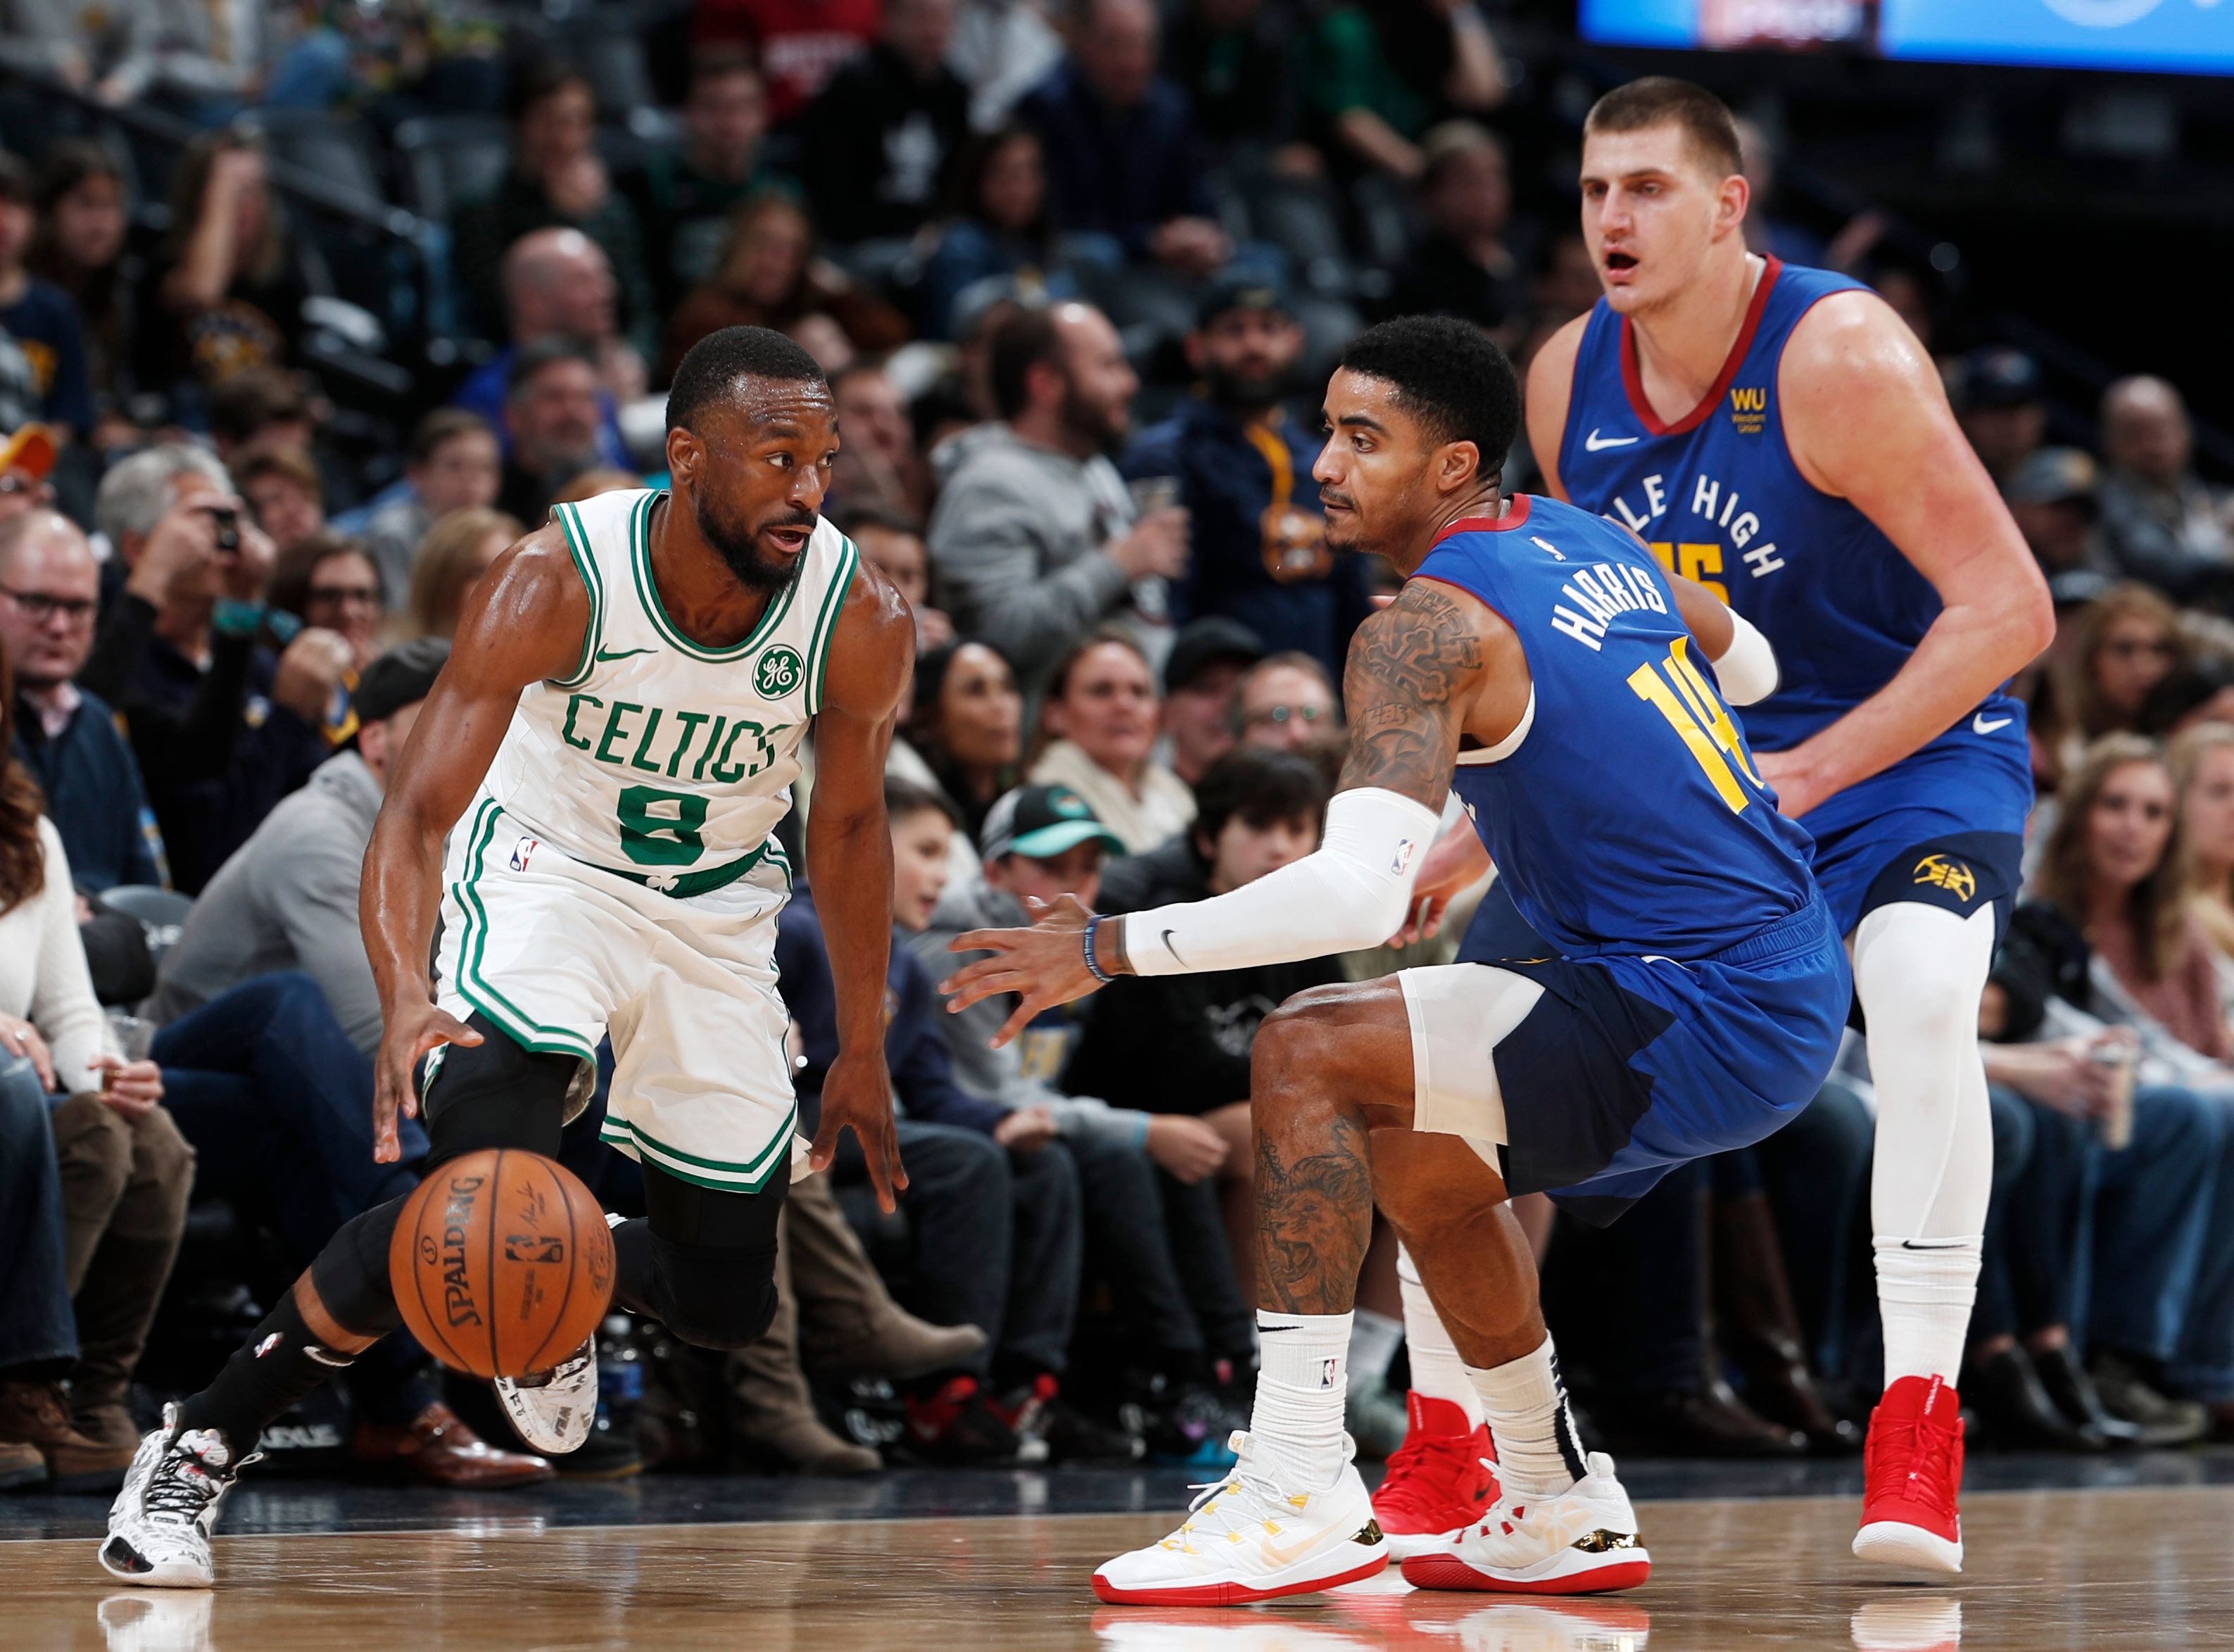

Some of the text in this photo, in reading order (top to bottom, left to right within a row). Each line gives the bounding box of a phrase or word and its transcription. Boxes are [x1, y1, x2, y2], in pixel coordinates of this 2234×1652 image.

[1731, 388, 1765, 411] WU
[1691, 474, 1785, 578] HIGH
[1551, 563, 1668, 652] HARRIS
[562, 693, 794, 783] CELTICS
[1626, 635, 1765, 815] 14
[617, 785, 711, 866] 8
[443, 1175, 484, 1328] SPALDING
